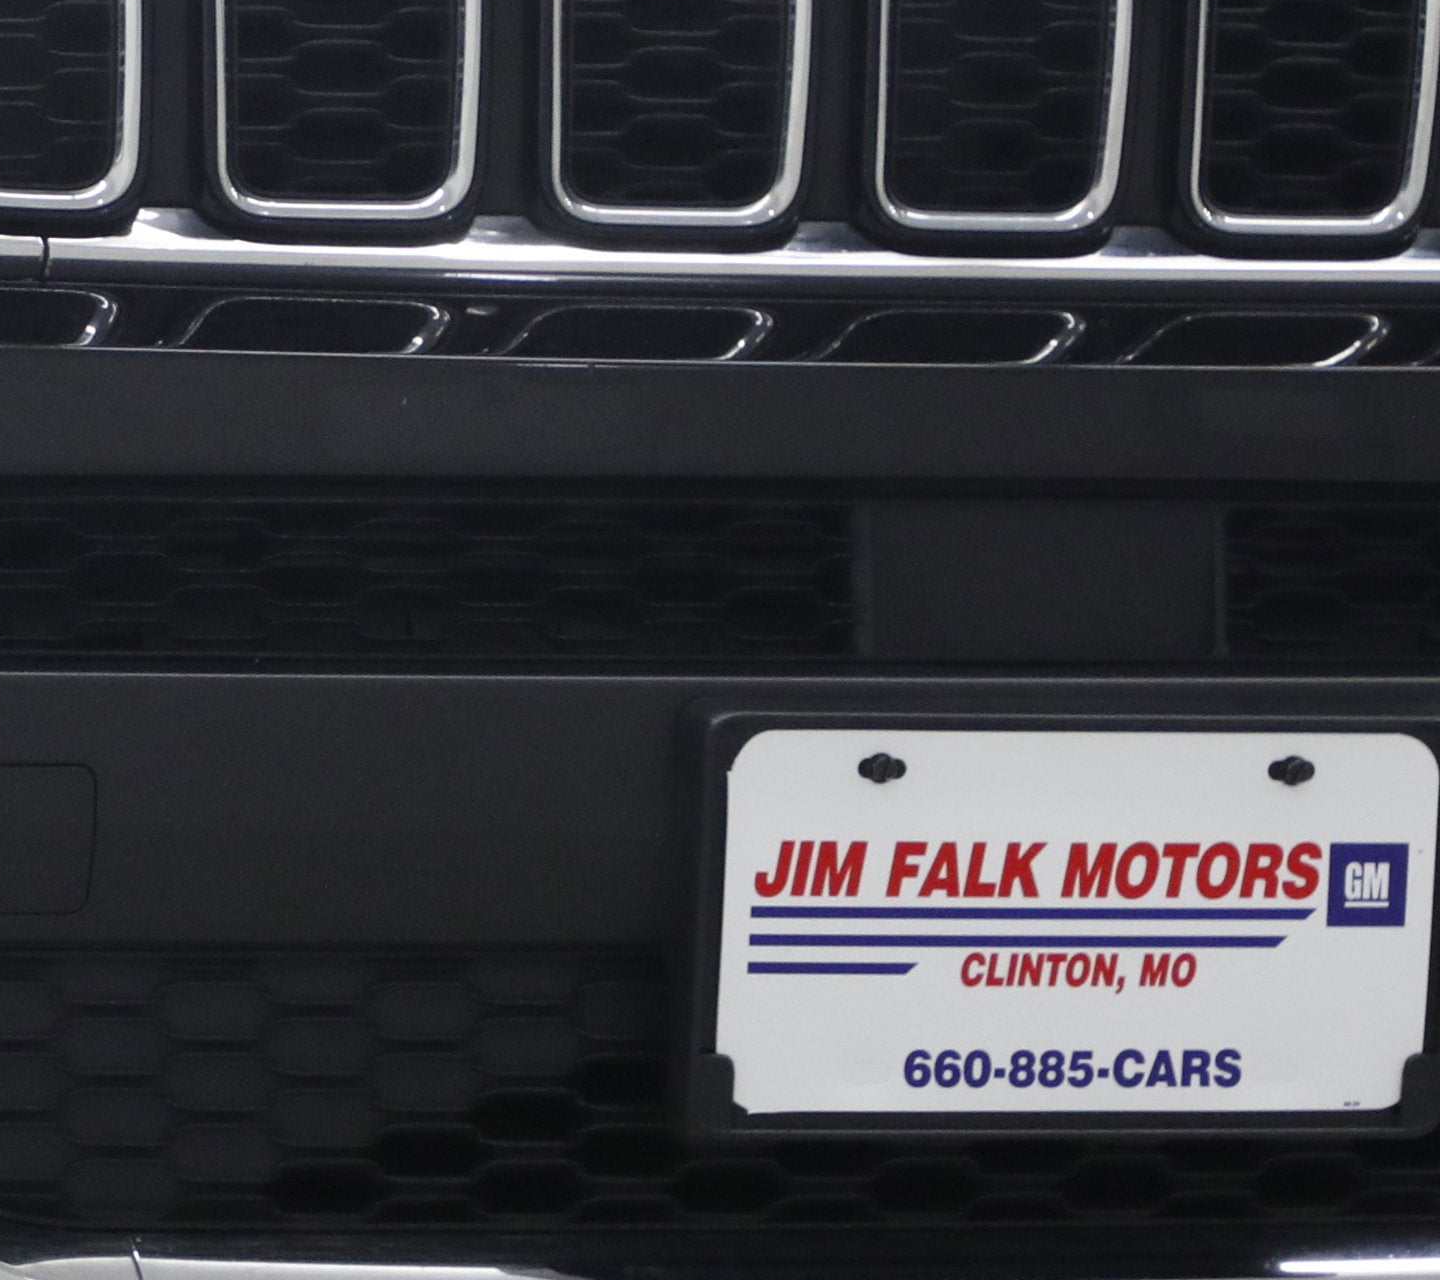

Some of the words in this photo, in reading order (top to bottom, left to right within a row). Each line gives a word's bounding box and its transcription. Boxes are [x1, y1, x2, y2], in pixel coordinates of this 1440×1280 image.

[754, 840, 868, 898] JIM
[885, 841, 1048, 898] FALK
[1060, 841, 1322, 900] MOTORS
[1344, 861, 1390, 901] GM
[960, 951, 1126, 994] CLINTON,
[1138, 952, 1197, 988] MO
[903, 1048, 1243, 1089] 660-885-CARS
